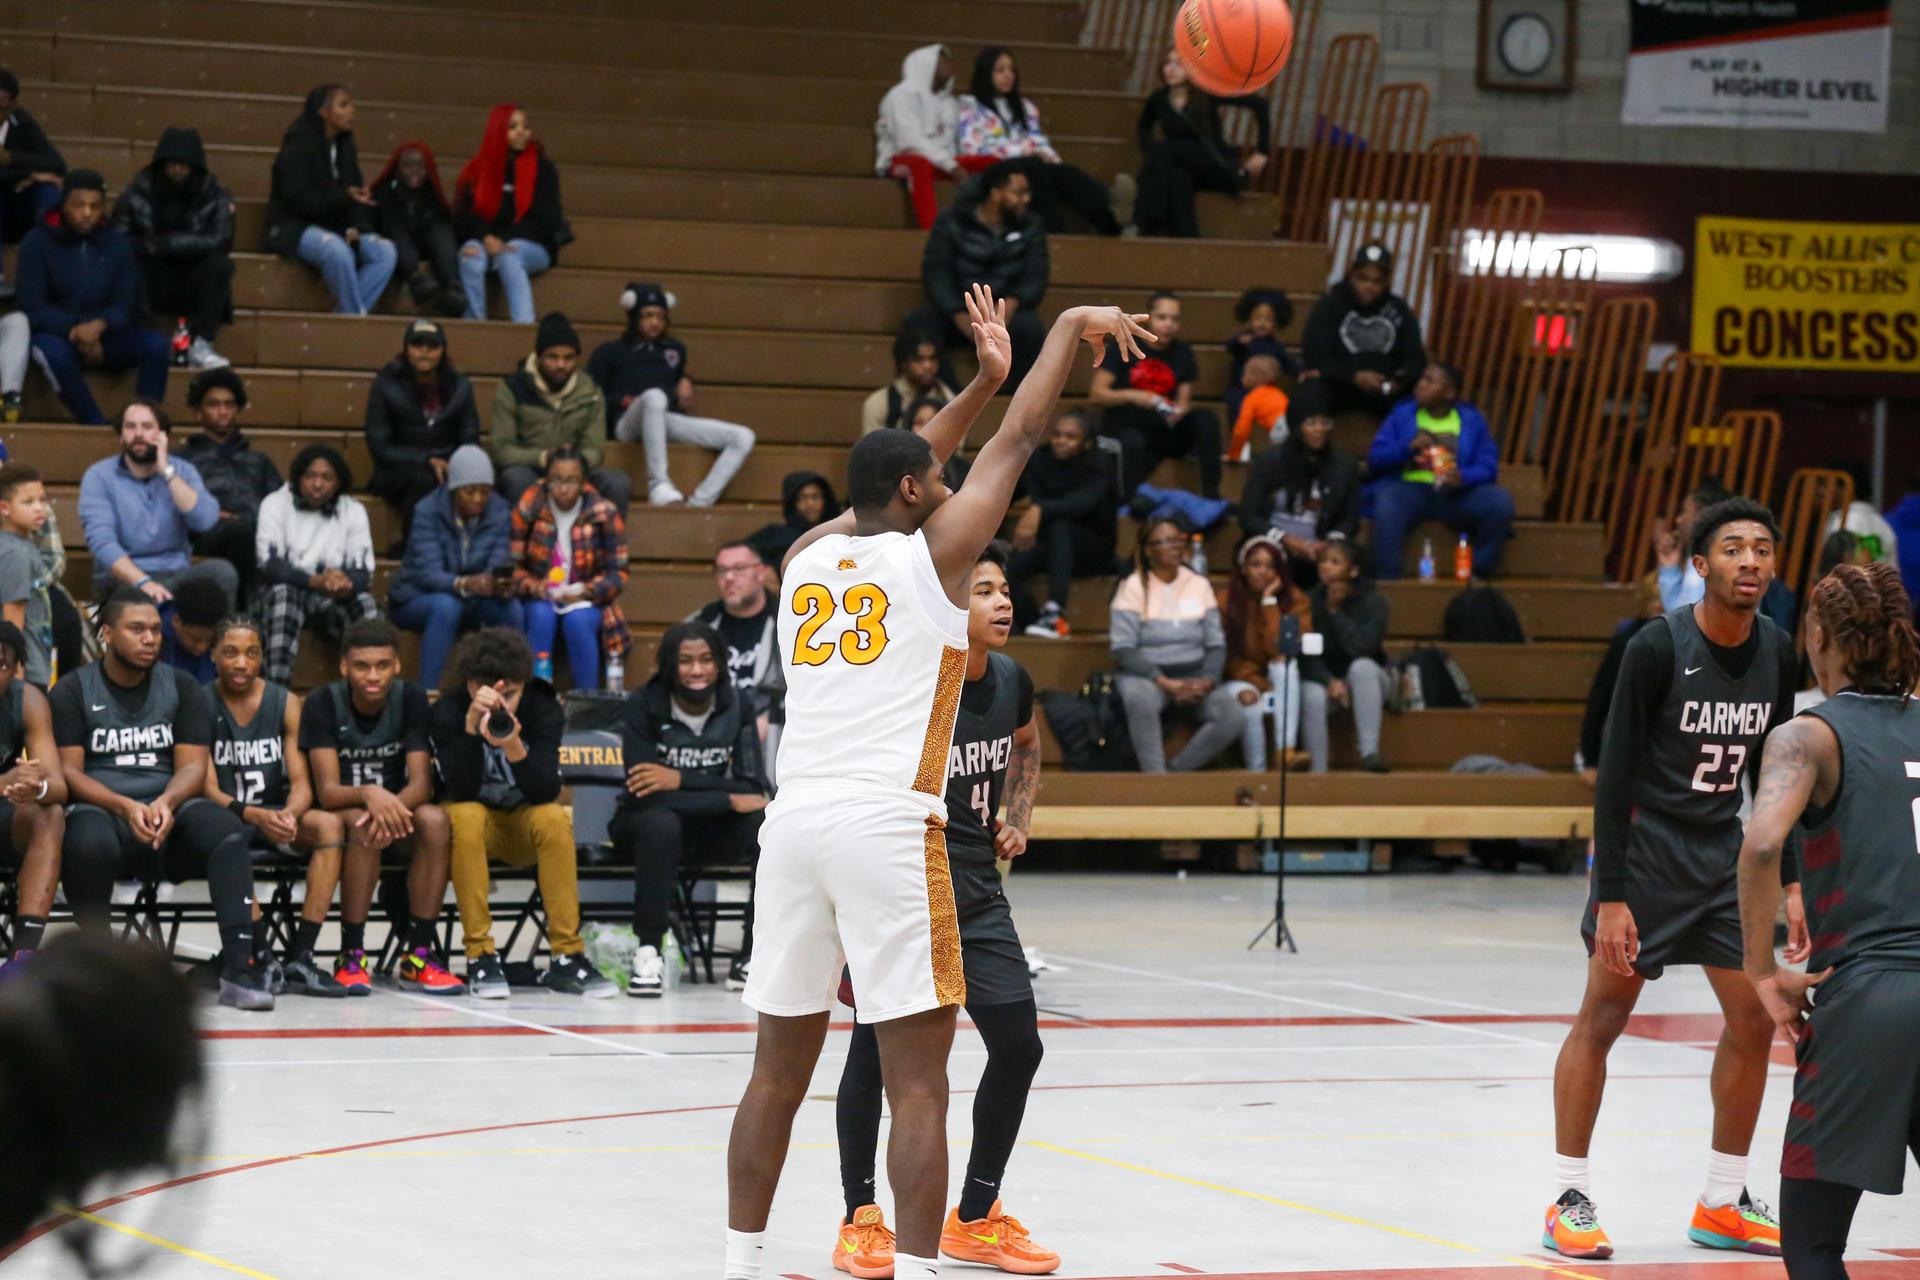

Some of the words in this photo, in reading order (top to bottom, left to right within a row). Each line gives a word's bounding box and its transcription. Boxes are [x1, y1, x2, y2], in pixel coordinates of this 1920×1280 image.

[1690, 58, 1726, 71] PLAY
[1731, 59, 1748, 72] AT
[1752, 60, 1761, 72] A
[1713, 77, 1800, 99] HIGHER
[1805, 80, 1878, 101] LEVEL
[1709, 229, 1793, 259] WEST
[1802, 234, 1889, 263] ALLIS
[1744, 264, 1909, 296] BOOSTERS
[1714, 306, 1919, 362] CONCESS
[791, 582, 891, 667] 23
[1679, 701, 1771, 735] CARMEN
[91, 723, 173, 753] CARMEN
[213, 736, 282, 766] CARMEN
[558, 746, 624, 765] ENTRAL
[1691, 743, 1746, 793] 23
[234, 770, 266, 805] 12
[351, 762, 384, 788] 15
[971, 780, 990, 827] 4
